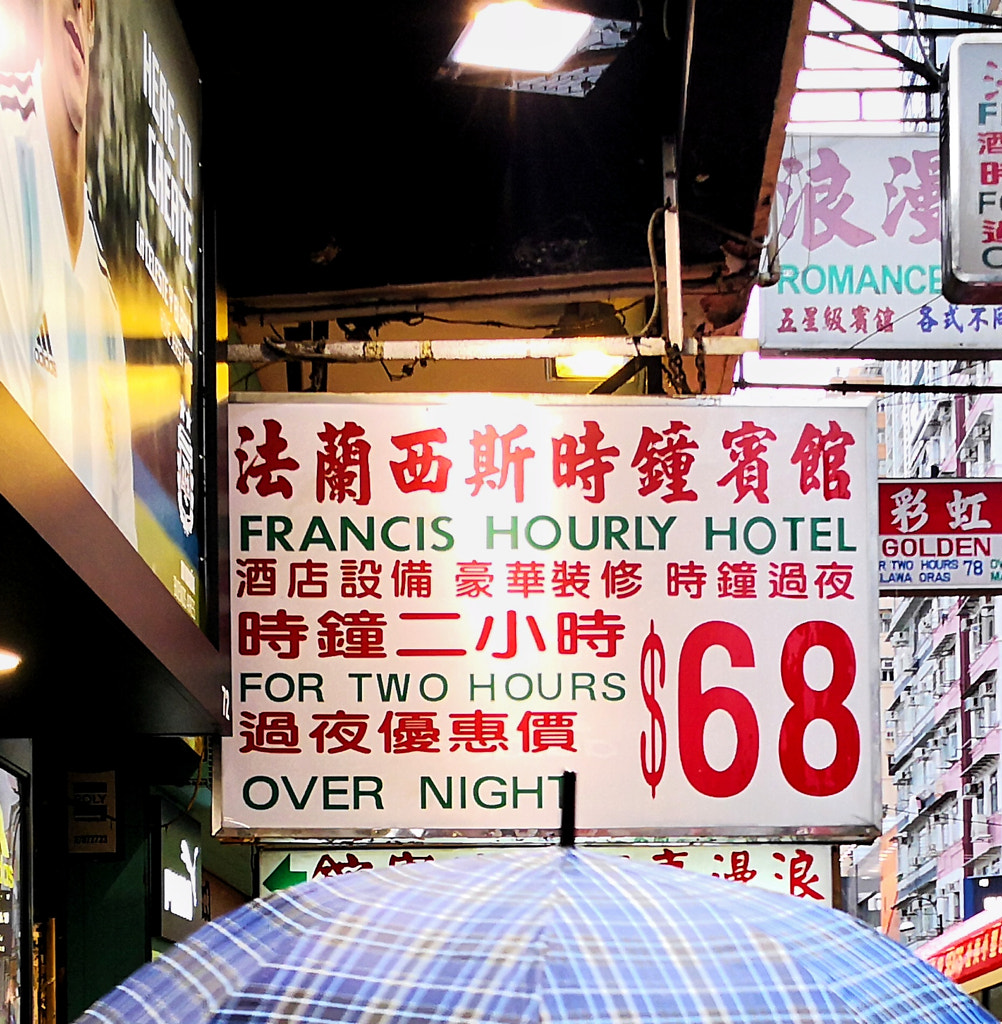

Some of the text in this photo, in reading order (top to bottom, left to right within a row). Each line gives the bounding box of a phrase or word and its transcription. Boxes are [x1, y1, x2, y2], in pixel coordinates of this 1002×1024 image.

[233, 418, 857, 506] 法蘭西斯時鐘賓館
[239, 515, 857, 555] FRANCIS HOURLY HOTEL
[881, 536, 991, 558] GOLDEN
[235, 559, 433, 600] 酒店設備
[454, 559, 644, 600] 豪華裝修
[666, 561, 856, 600] 時鐘過夜
[920, 559, 959, 570] HOURS
[962, 560, 984, 577] 78
[237, 608, 626, 660] 時鐘二小時
[239, 671, 326, 703] FOR
[348, 671, 450, 703] TWO
[469, 671, 627, 703] HOURS
[639, 618, 862, 800] $68
[238, 709, 579, 756] 過夜優惠價
[241, 774, 565, 812] OVER NIGHT
